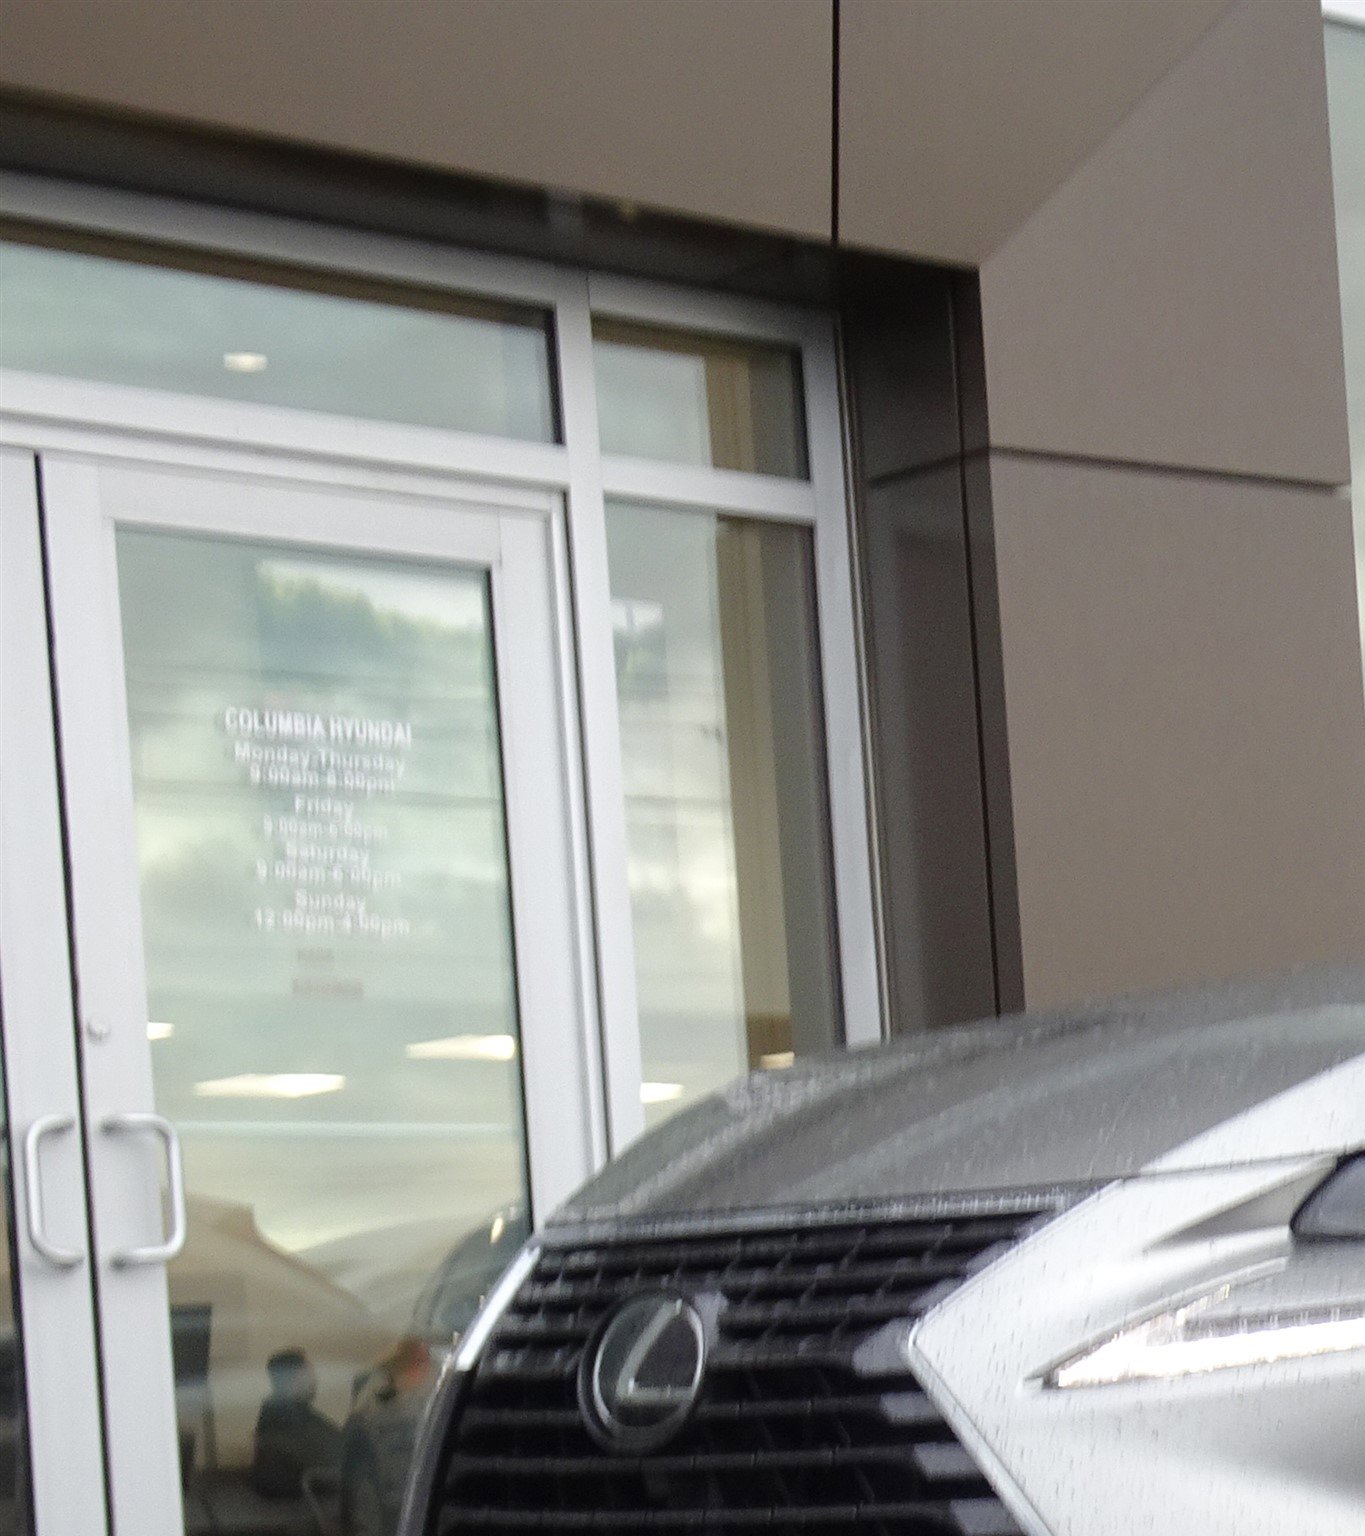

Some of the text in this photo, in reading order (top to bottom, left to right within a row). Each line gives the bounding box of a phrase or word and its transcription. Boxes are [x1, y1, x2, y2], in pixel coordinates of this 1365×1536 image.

[225, 706, 412, 748] COLUMBIA HYUNDAI
[295, 794, 353, 819] Friday
[295, 889, 366, 912] Sunday
